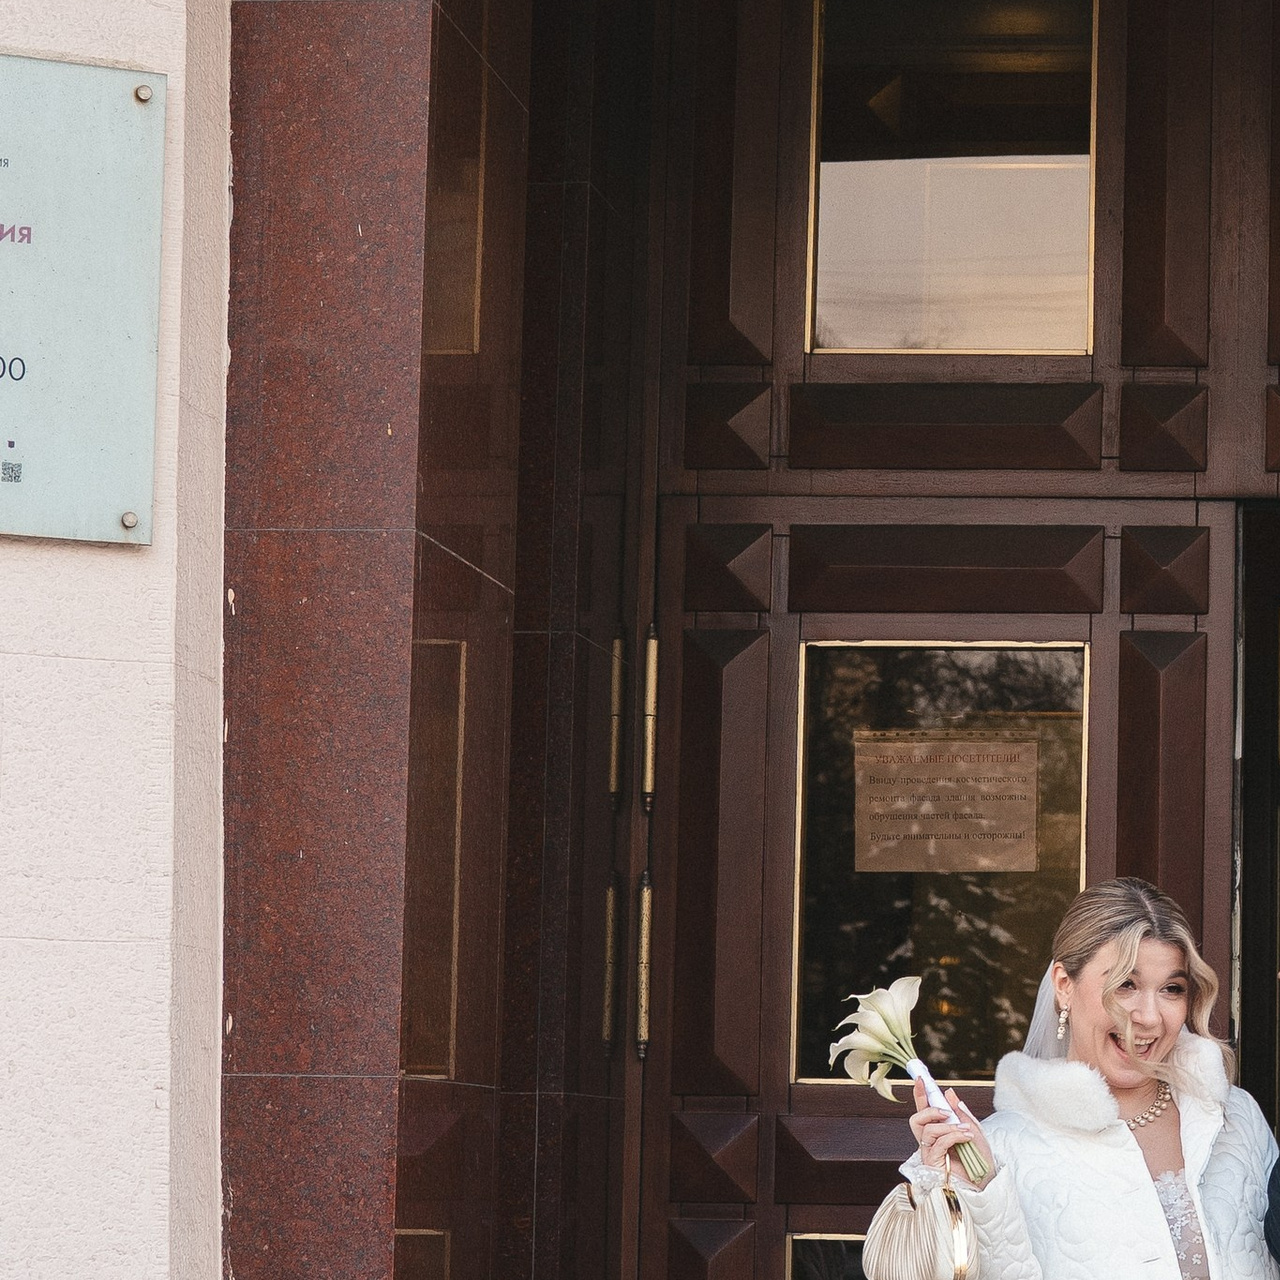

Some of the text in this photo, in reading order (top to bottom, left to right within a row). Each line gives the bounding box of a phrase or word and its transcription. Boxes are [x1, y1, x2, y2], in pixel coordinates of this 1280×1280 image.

[874, 753, 1021, 765] УВАЖАЕМЫЕ ПОСЕТИТЕЛИ!
[868, 775, 1027, 786] Ввиду проведения косметического
[868, 794, 1027, 804] ремонта фасада здания возможны
[868, 811, 919, 822] обрушения
[920, 810, 950, 820] частей
[870, 831, 900, 842] Будьте
[902, 832, 962, 841] внимательны
[971, 830, 1026, 842] осторожны!
